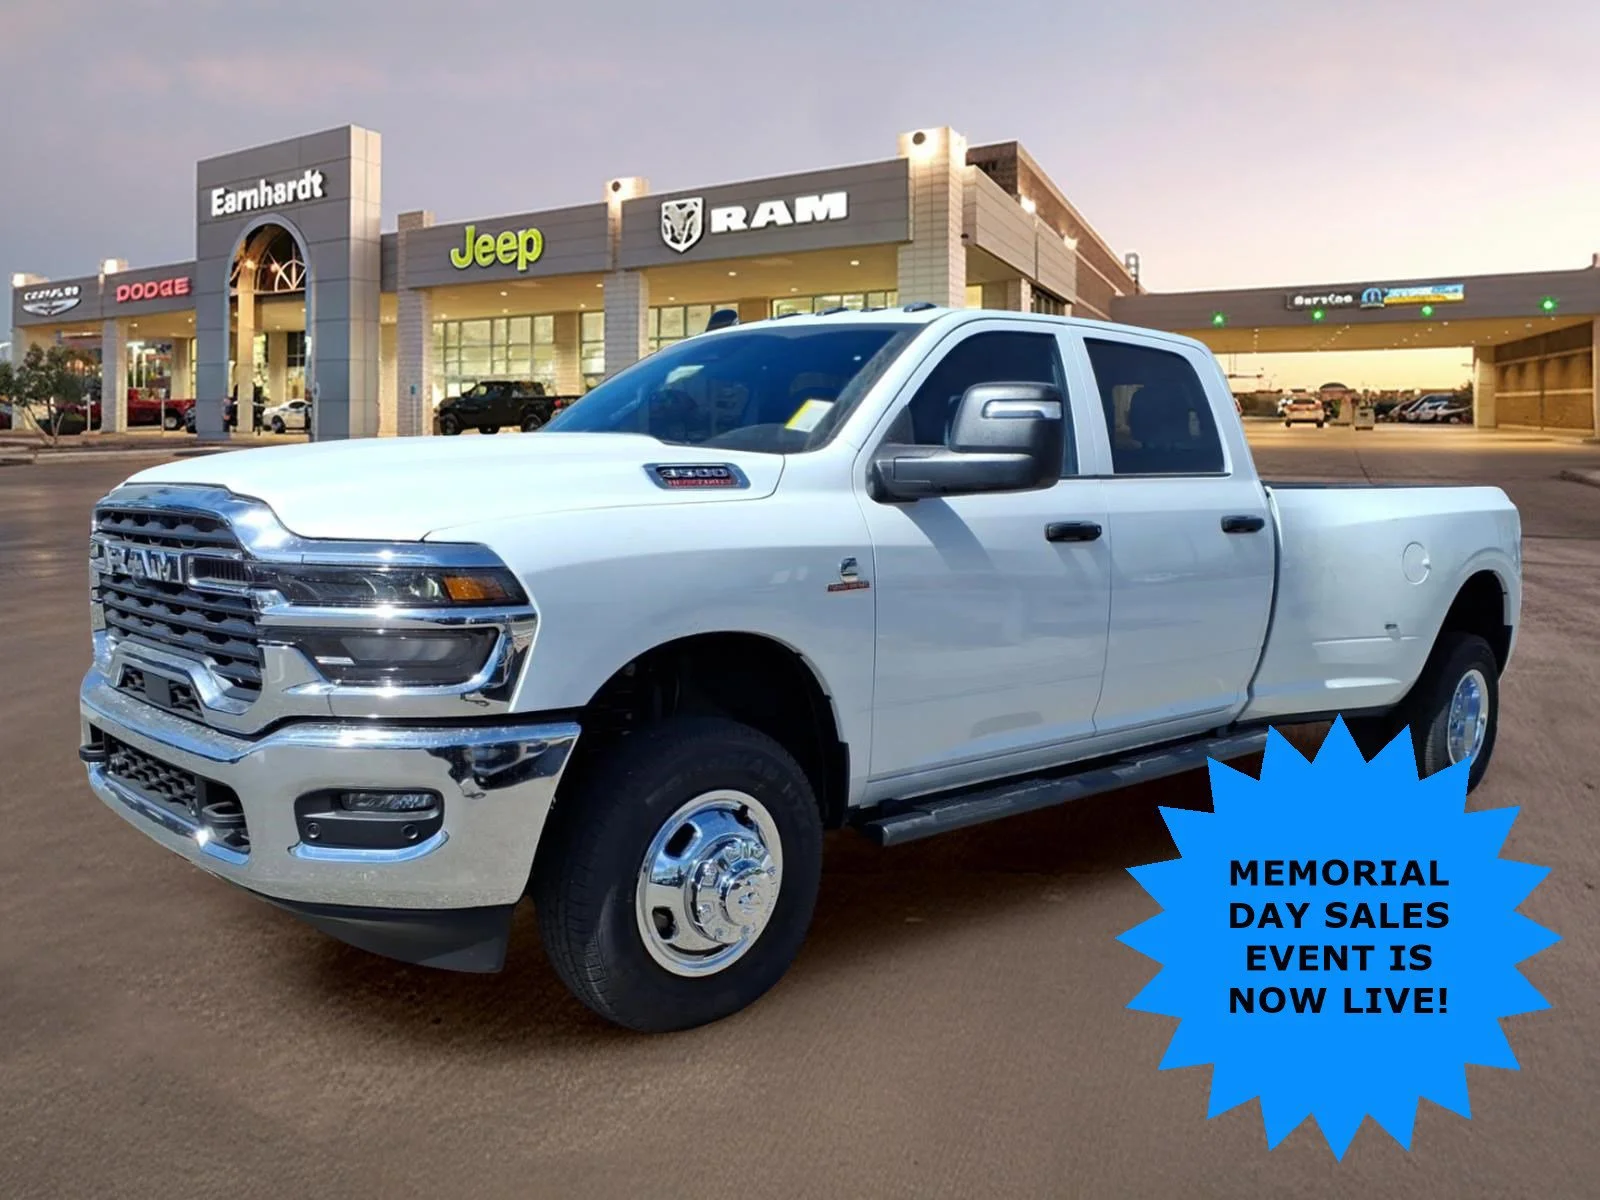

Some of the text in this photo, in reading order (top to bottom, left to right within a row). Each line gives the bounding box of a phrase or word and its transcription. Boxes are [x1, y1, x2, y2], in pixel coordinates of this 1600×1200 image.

[211, 169, 324, 217] Earnhardt
[711, 191, 848, 234] RAM
[450, 225, 543, 271] Jeep
[116, 277, 190, 302] DODGE
[103, 541, 183, 584] RAM
